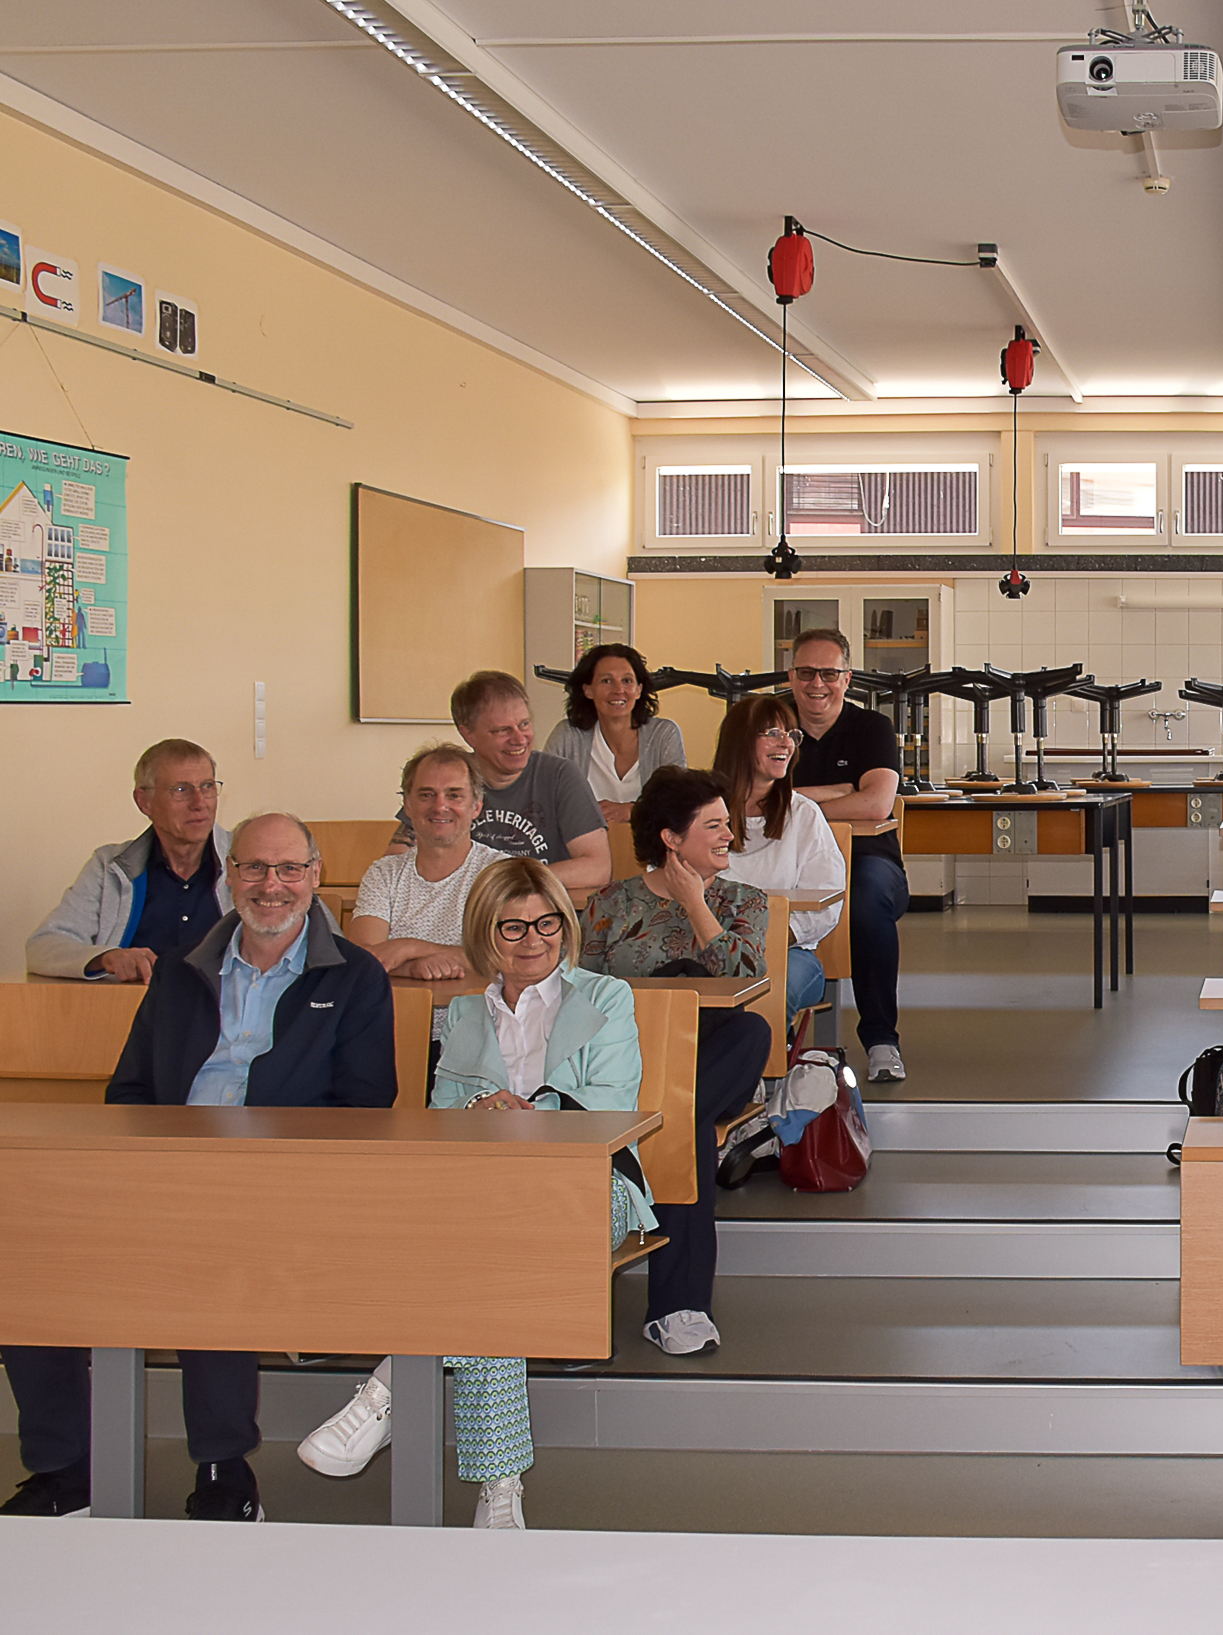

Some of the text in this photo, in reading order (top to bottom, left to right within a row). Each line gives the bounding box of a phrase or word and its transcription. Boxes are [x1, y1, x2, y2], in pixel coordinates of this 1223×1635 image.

[28, 447, 48, 465] WIE
[52, 452, 81, 471] GEHT
[495, 809, 549, 855] HERITAGE
